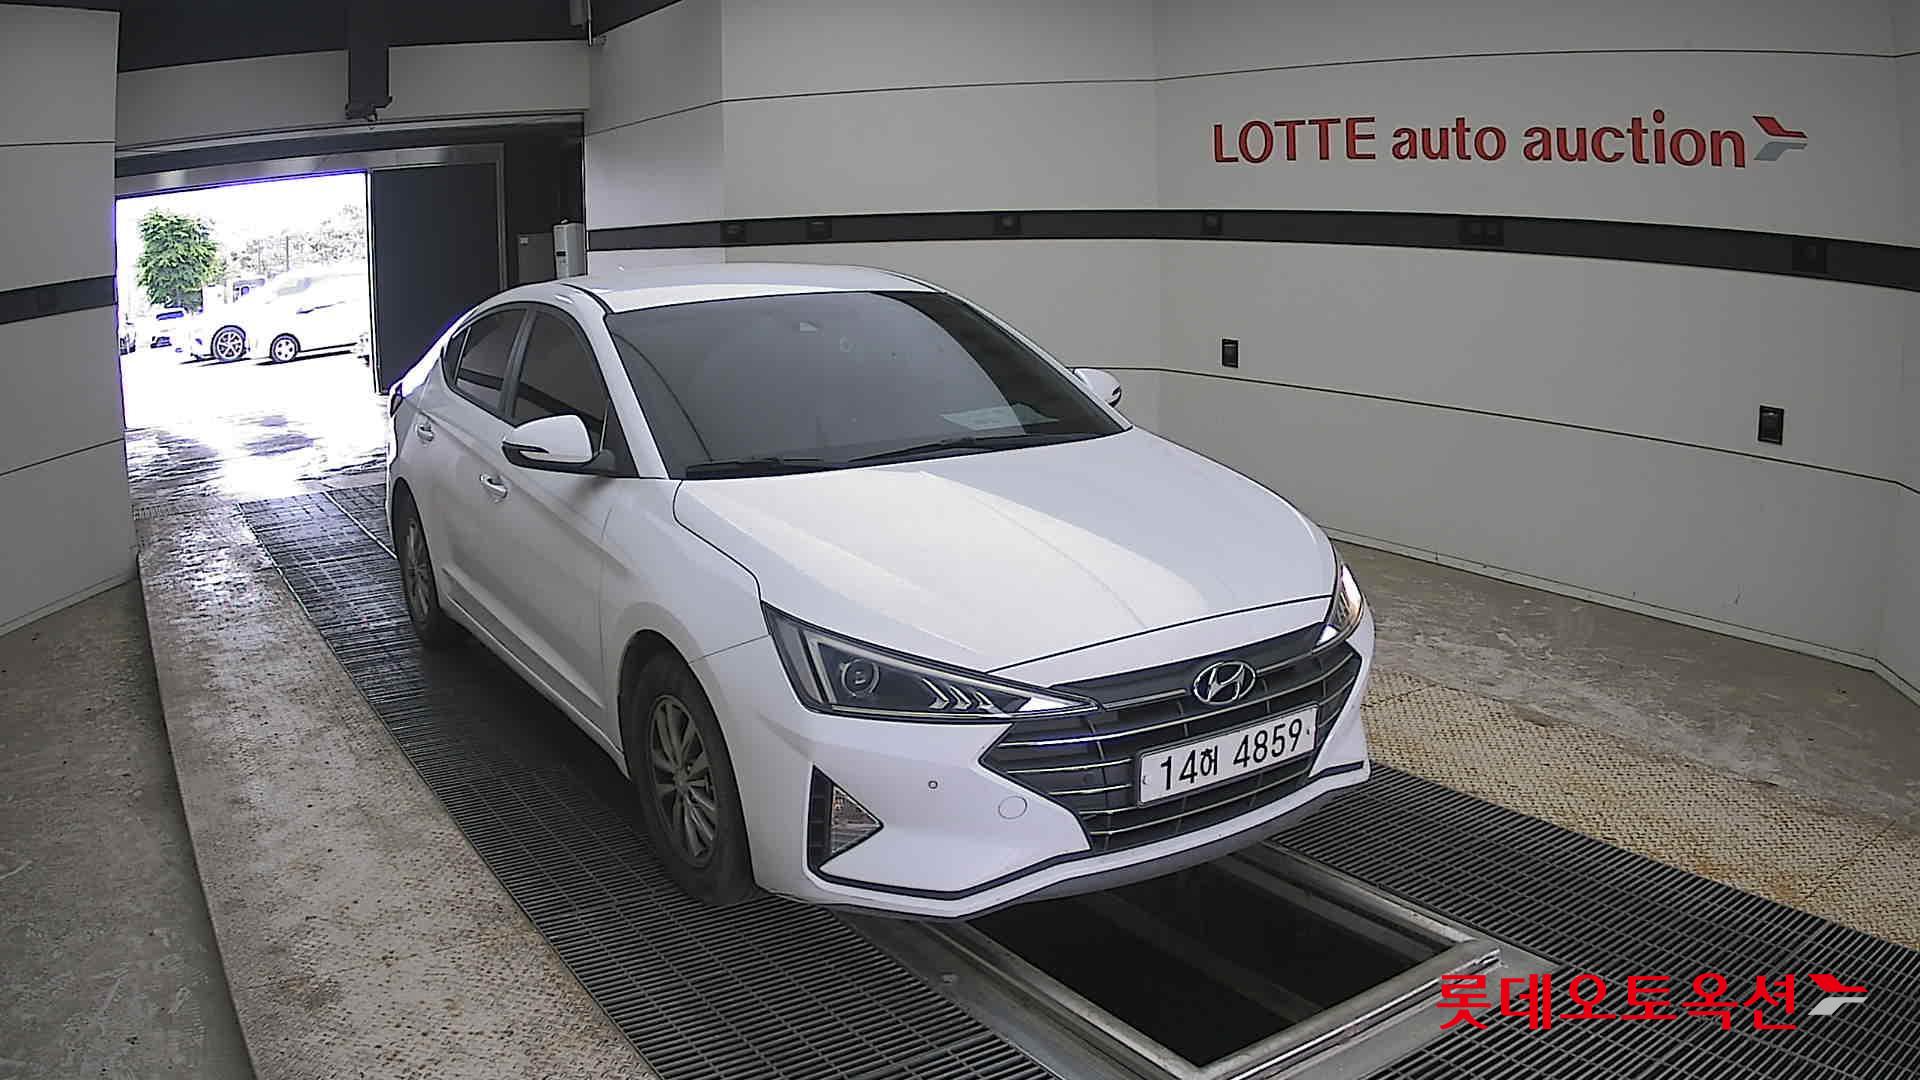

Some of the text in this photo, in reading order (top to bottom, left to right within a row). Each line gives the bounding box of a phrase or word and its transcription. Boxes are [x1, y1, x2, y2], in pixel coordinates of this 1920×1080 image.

[1213, 109, 1747, 169] LOTTE auto auction
[1160, 718, 1304, 791] 14허 4859
